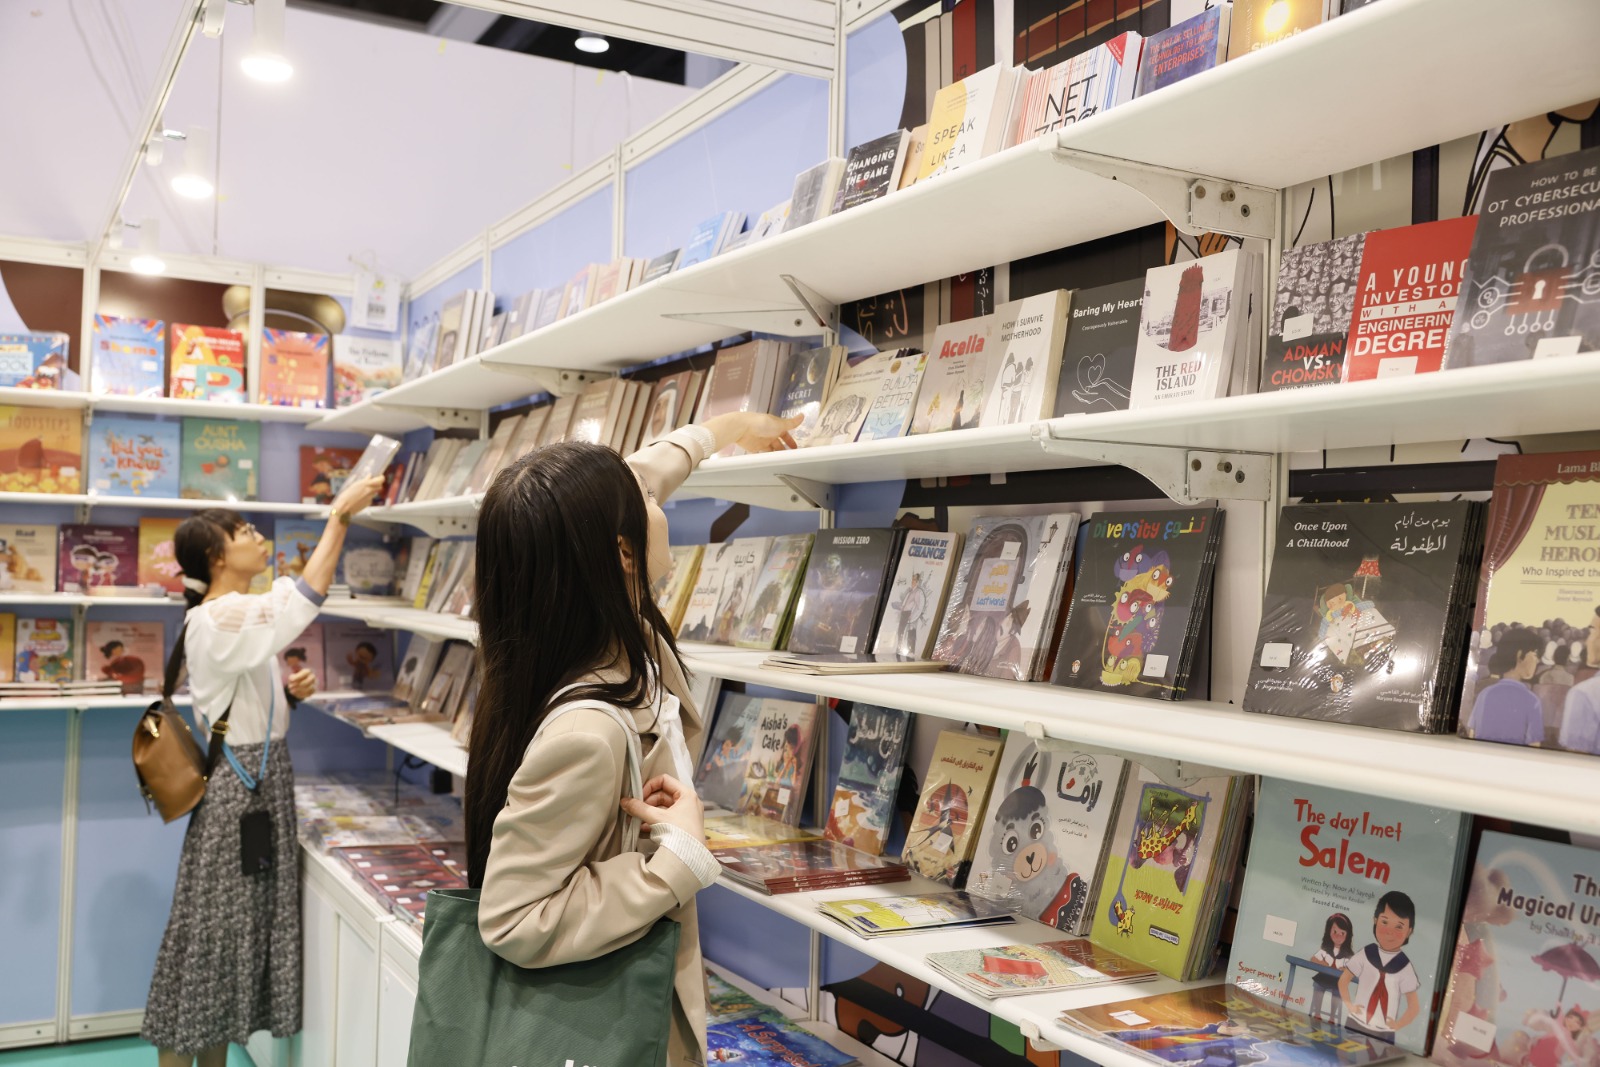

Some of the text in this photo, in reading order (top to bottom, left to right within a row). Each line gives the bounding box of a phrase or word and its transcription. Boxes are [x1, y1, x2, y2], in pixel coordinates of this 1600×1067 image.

[1153, 44, 1205, 77] ENTERPRISES
[1044, 73, 1097, 123] NET
[933, 116, 976, 145] SPEAK
[846, 149, 895, 173] CHANGING
[930, 147, 955, 167] LIKE
[958, 143, 966, 155] A
[845, 165, 889, 187] THE GAME
[1530, 166, 1597, 188] HOW TO BE
[1487, 199, 1509, 214] OT
[1365, 272, 1376, 292] A
[1073, 297, 1144, 319] Baring My Heart
[1361, 300, 1447, 318] WITH A
[1002, 321, 1016, 331] HOW
[1019, 313, 1044, 327] SURVIVE
[1000, 326, 1042, 343] MOTHERHOOD
[939, 333, 986, 360] Acella
[1282, 339, 1343, 363] ADMAN
[1155, 360, 1202, 378] THE RED
[1303, 354, 1331, 371] VS.
[1156, 373, 1197, 391] ISLAND
[1271, 363, 1343, 386] CHOMSKY
[787, 388, 812, 401] SECRET
[874, 391, 913, 409] BETTER
[202, 423, 240, 438] AUNT
[1557, 463, 1587, 474] Lama
[1294, 521, 1348, 533] Once Upon
[1394, 511, 1451, 532] يوم من أيام
[832, 535, 871, 545] MISSION ZERO
[1286, 538, 1350, 549] A Childhood
[1390, 534, 1447, 556] الطفولة
[908, 545, 947, 560] CHANCE
[1522, 566, 1543, 577] Who
[1545, 567, 1585, 579] Inspired
[760, 712, 788, 732] Aisha's
[761, 734, 781, 752] Cake
[1293, 798, 1402, 842] The day I met
[1298, 824, 1391, 885] Salem
[1135, 889, 1153, 904] Neck
[1497, 887, 1576, 922] Magical
[1331, 901, 1350, 911] Edition
[1530, 920, 1543, 935] by
[1238, 961, 1276, 981] Super power
[1269, 989, 1276, 997] of
